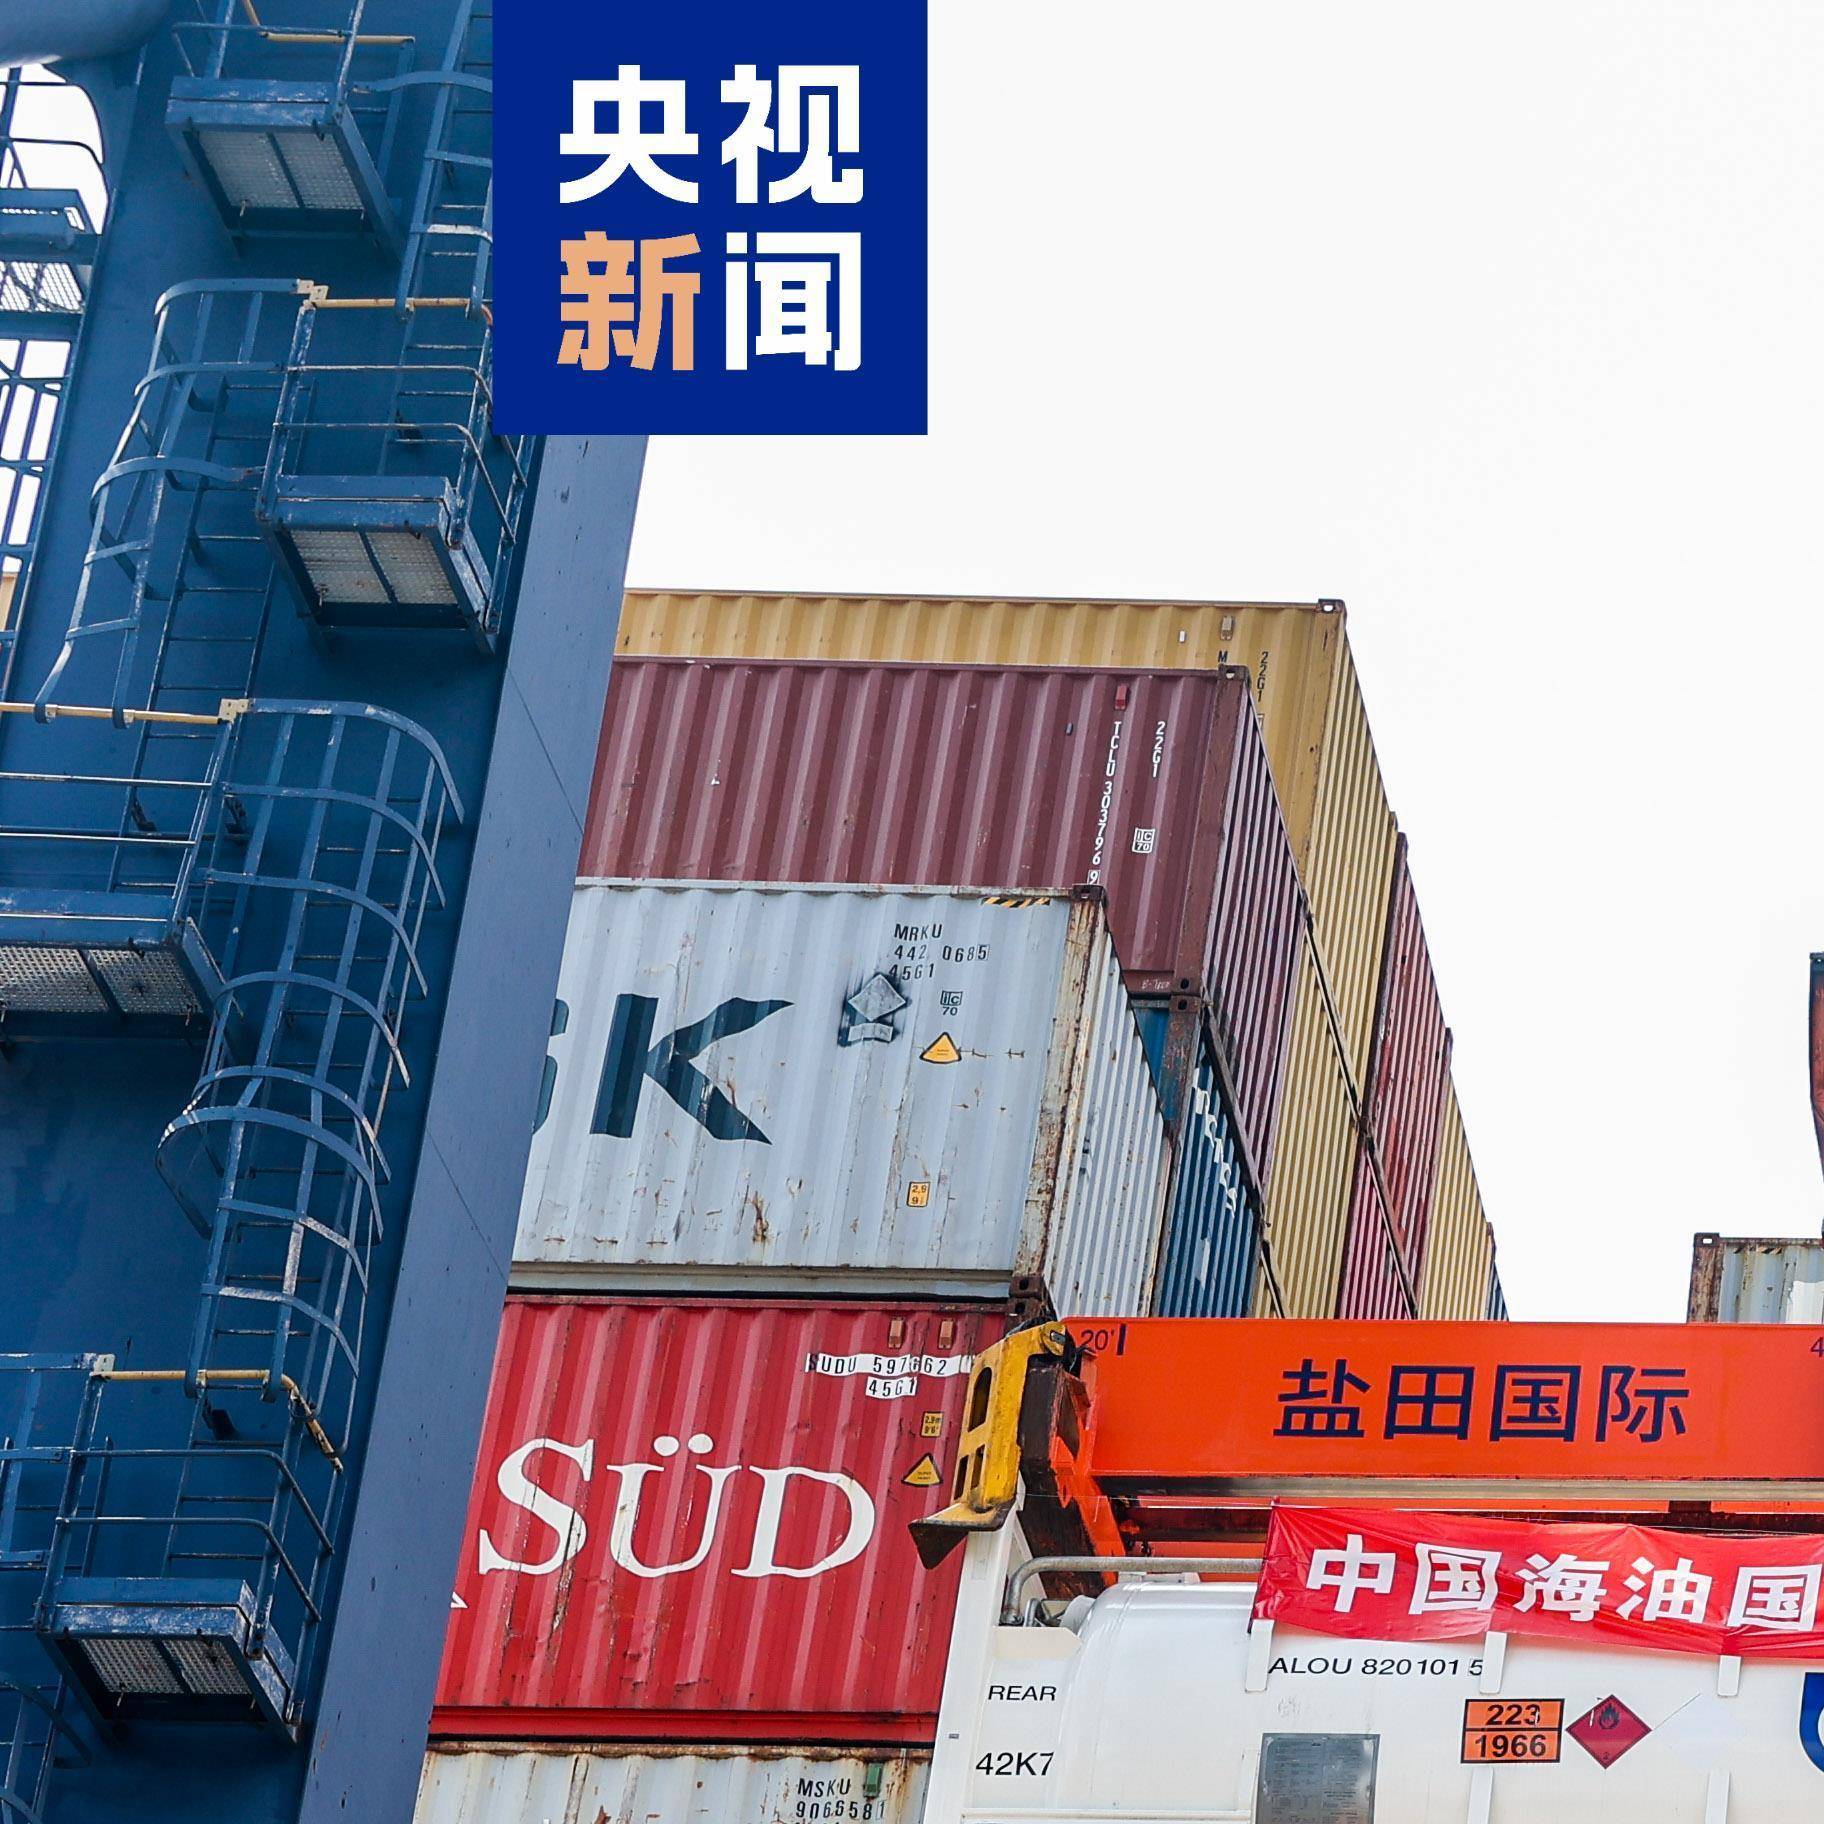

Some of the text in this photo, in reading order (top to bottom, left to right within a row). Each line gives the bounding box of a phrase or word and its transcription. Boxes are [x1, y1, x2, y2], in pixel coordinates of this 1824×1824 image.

[1106, 721, 1122, 777] TCLU
[1151, 721, 1166, 777] 22G1
[894, 924, 943, 942] MRKU
[889, 963, 935, 981] 45G1
[1273, 1358, 1689, 1444] 盐田国际
[479, 1434, 876, 1580] SÜD
[1268, 1657, 1353, 1675] ALOU
[988, 1684, 1057, 1703] REAR
[1487, 1704, 1541, 1726] 223
[1475, 1734, 1547, 1758] 1966
[974, 1751, 1055, 1779] 42K7
[797, 1778, 851, 1797] MSKU
